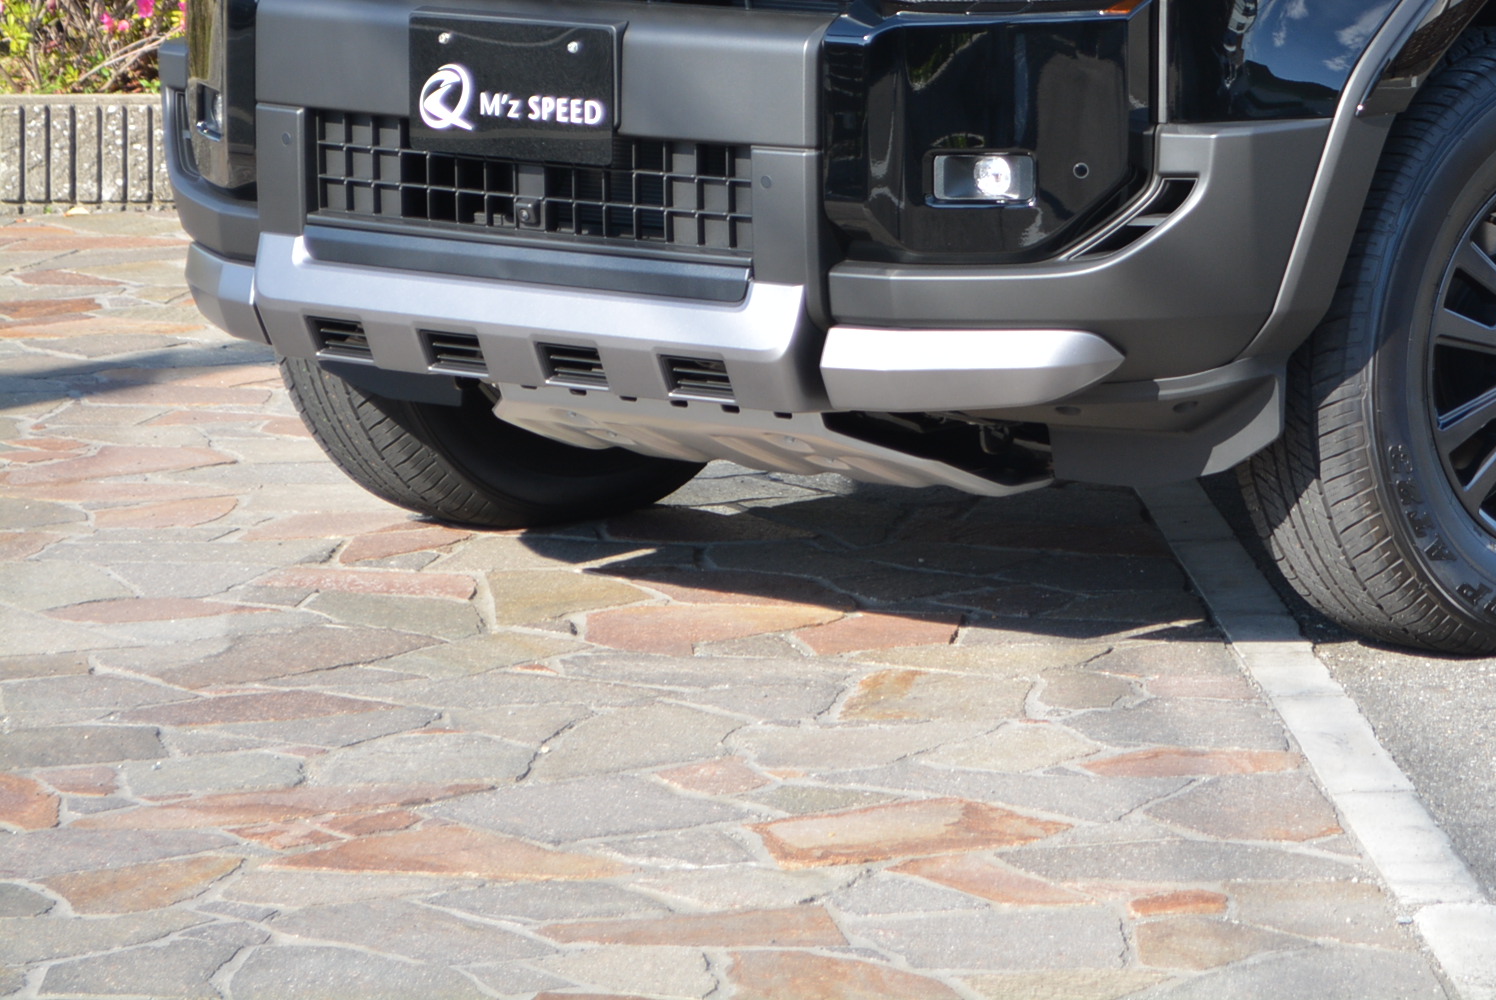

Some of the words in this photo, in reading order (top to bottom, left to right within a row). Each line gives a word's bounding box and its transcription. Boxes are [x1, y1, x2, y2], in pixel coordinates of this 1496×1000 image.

[479, 91, 521, 120] M'z
[527, 95, 604, 126] SPEED
[1388, 444, 1457, 562] AT23
